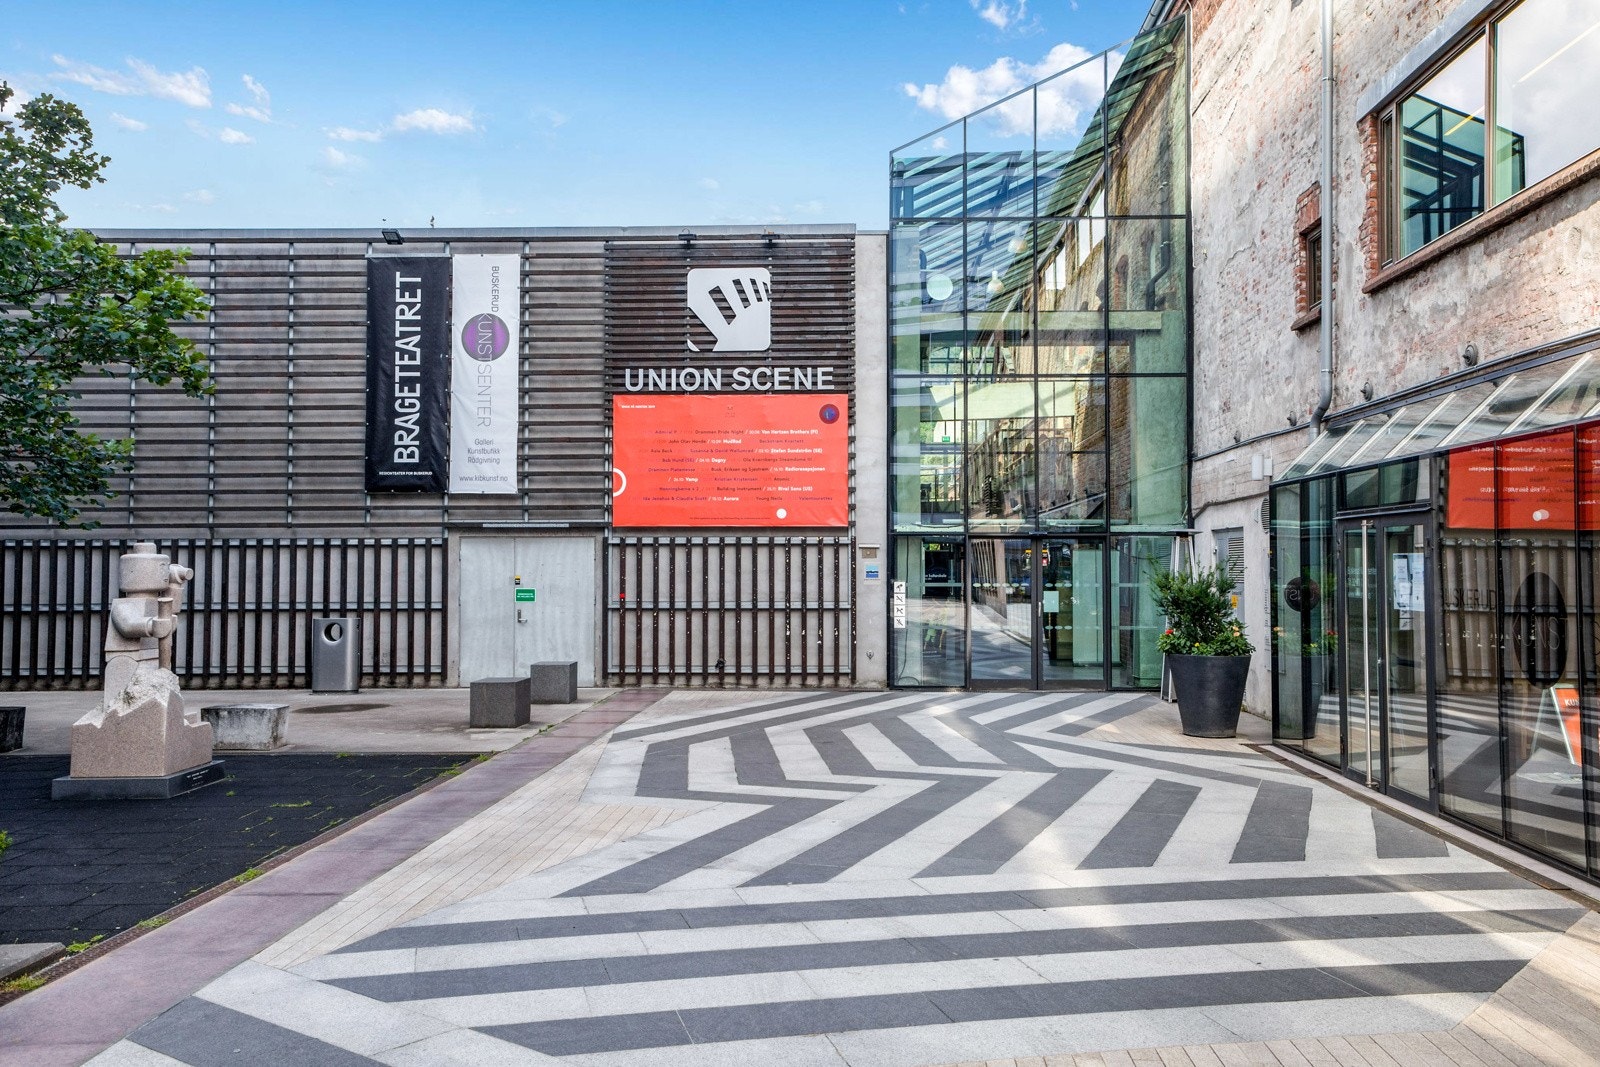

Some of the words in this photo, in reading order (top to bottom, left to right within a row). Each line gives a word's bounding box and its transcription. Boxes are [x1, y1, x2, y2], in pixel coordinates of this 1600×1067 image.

[491, 265, 499, 313] BUSKERUD
[393, 271, 421, 464] BRAGETEATRET
[476, 312, 492, 427] KUNSTSENTER
[624, 367, 722, 391] UNION
[731, 366, 835, 391] SCENE
[474, 438, 494, 446] Galleri
[467, 456, 500, 465] Rådgivning
